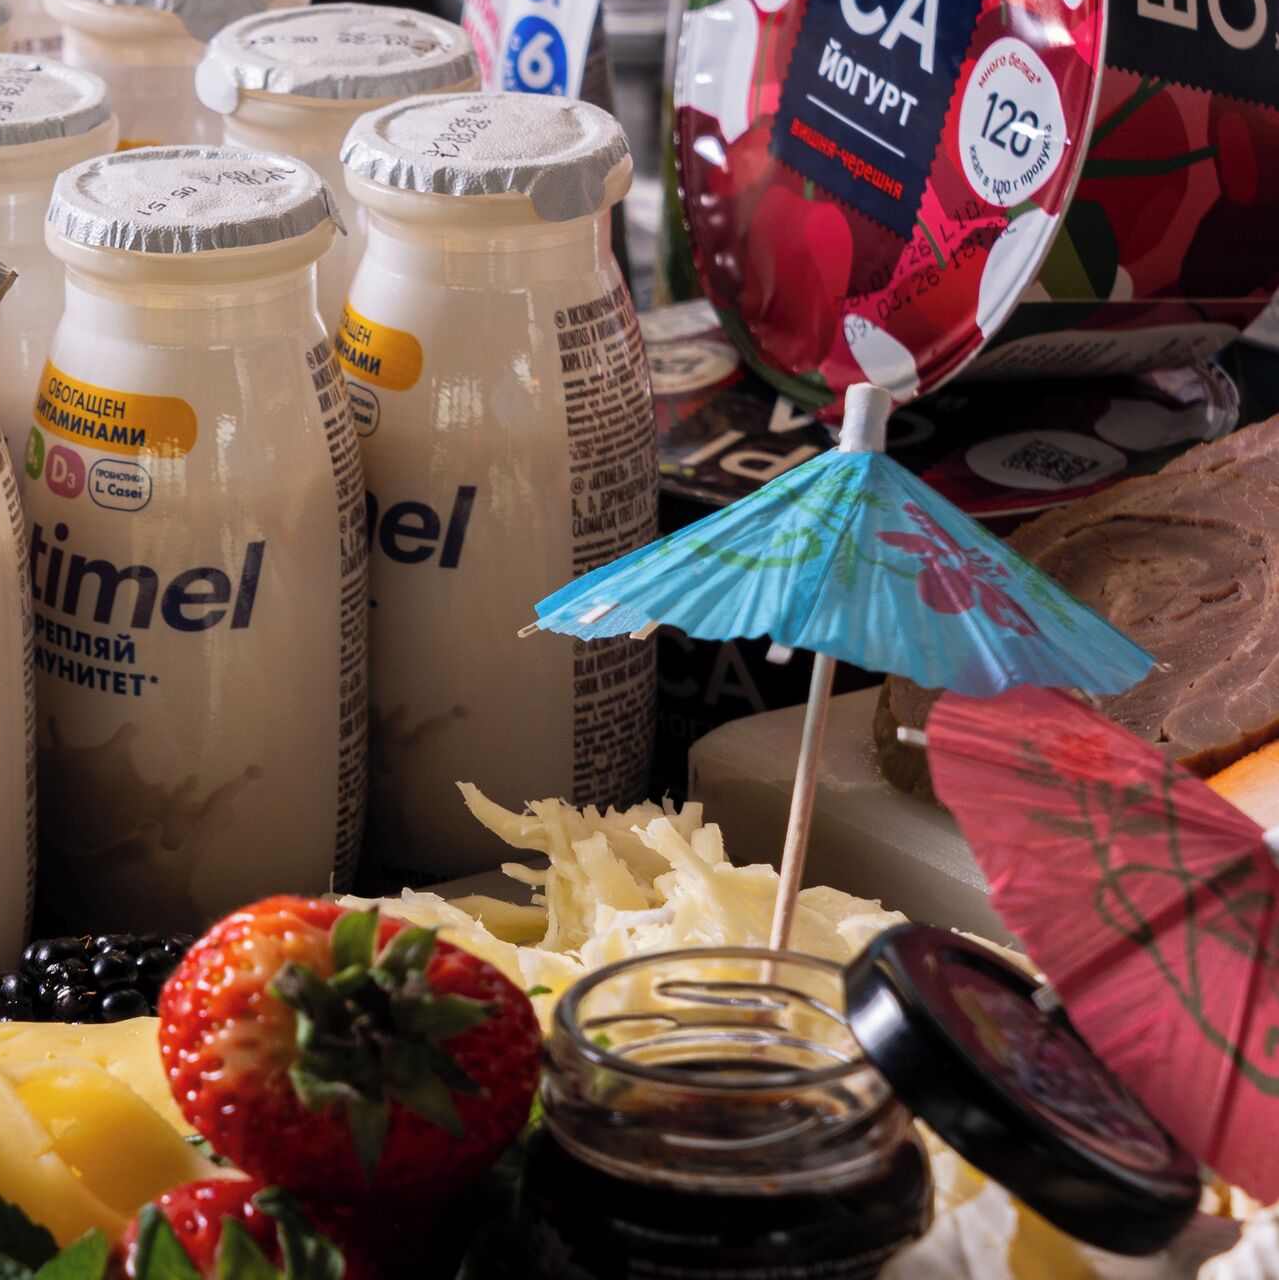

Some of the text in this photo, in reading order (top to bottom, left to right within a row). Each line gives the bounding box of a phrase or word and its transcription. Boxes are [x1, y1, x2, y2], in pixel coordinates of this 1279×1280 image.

[47, 376, 127, 421] ОБОГАЩЕН
[50, 453, 77, 490] D3
[107, 482, 144, 501] Casei
[30, 521, 267, 634] timel
